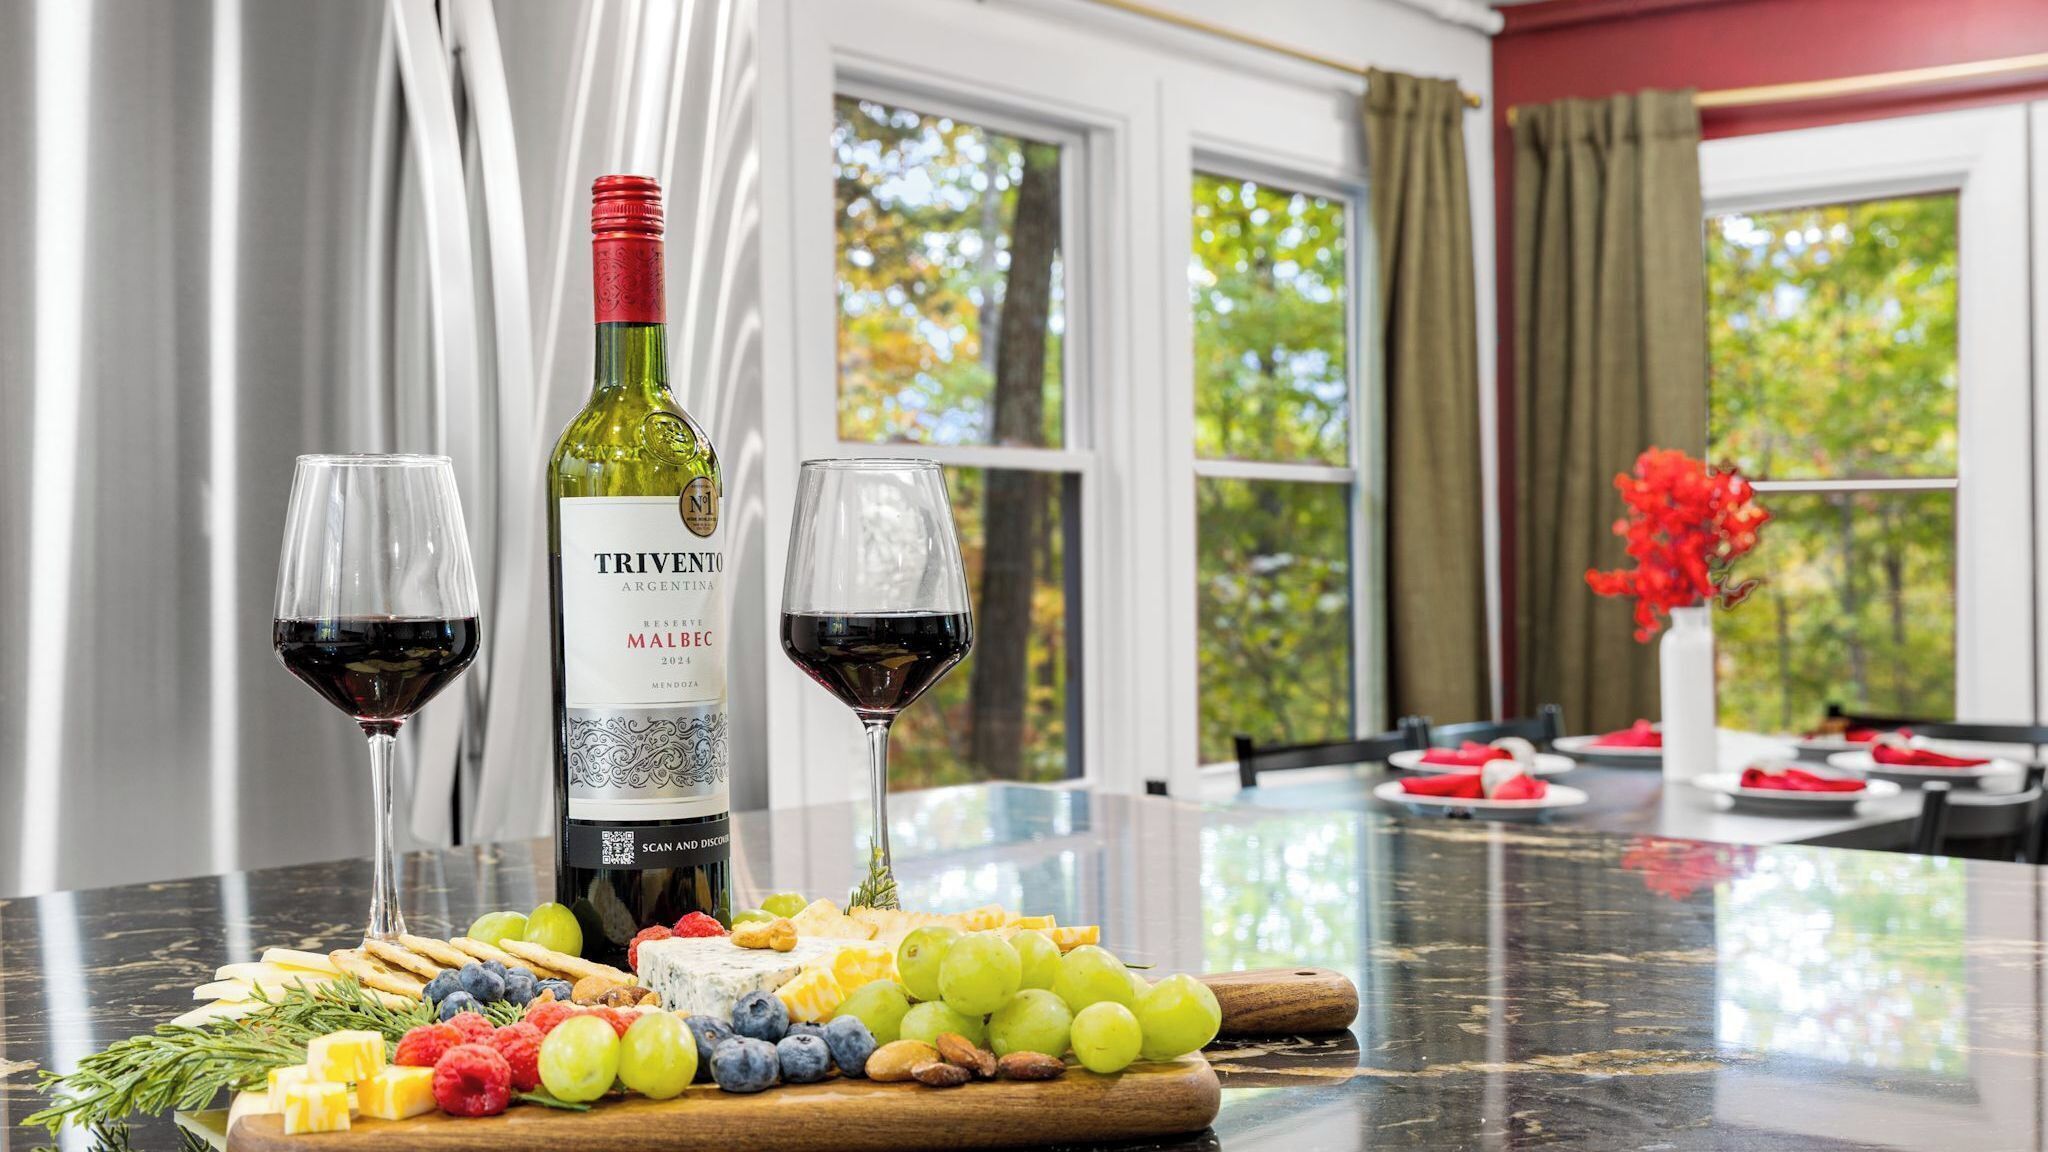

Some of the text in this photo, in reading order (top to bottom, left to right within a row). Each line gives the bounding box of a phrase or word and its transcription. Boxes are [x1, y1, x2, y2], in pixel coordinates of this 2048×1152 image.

[595, 552, 724, 574] TRIVENTO
[621, 581, 715, 592] ARGENTINA
[644, 619, 703, 628] RESERVE
[627, 630, 713, 649] MALBEC
[661, 656, 691, 665] 2024
[651, 681, 699, 689] MENDOZA
[642, 842, 673, 853] SCAN
[675, 840, 699, 851] AND
